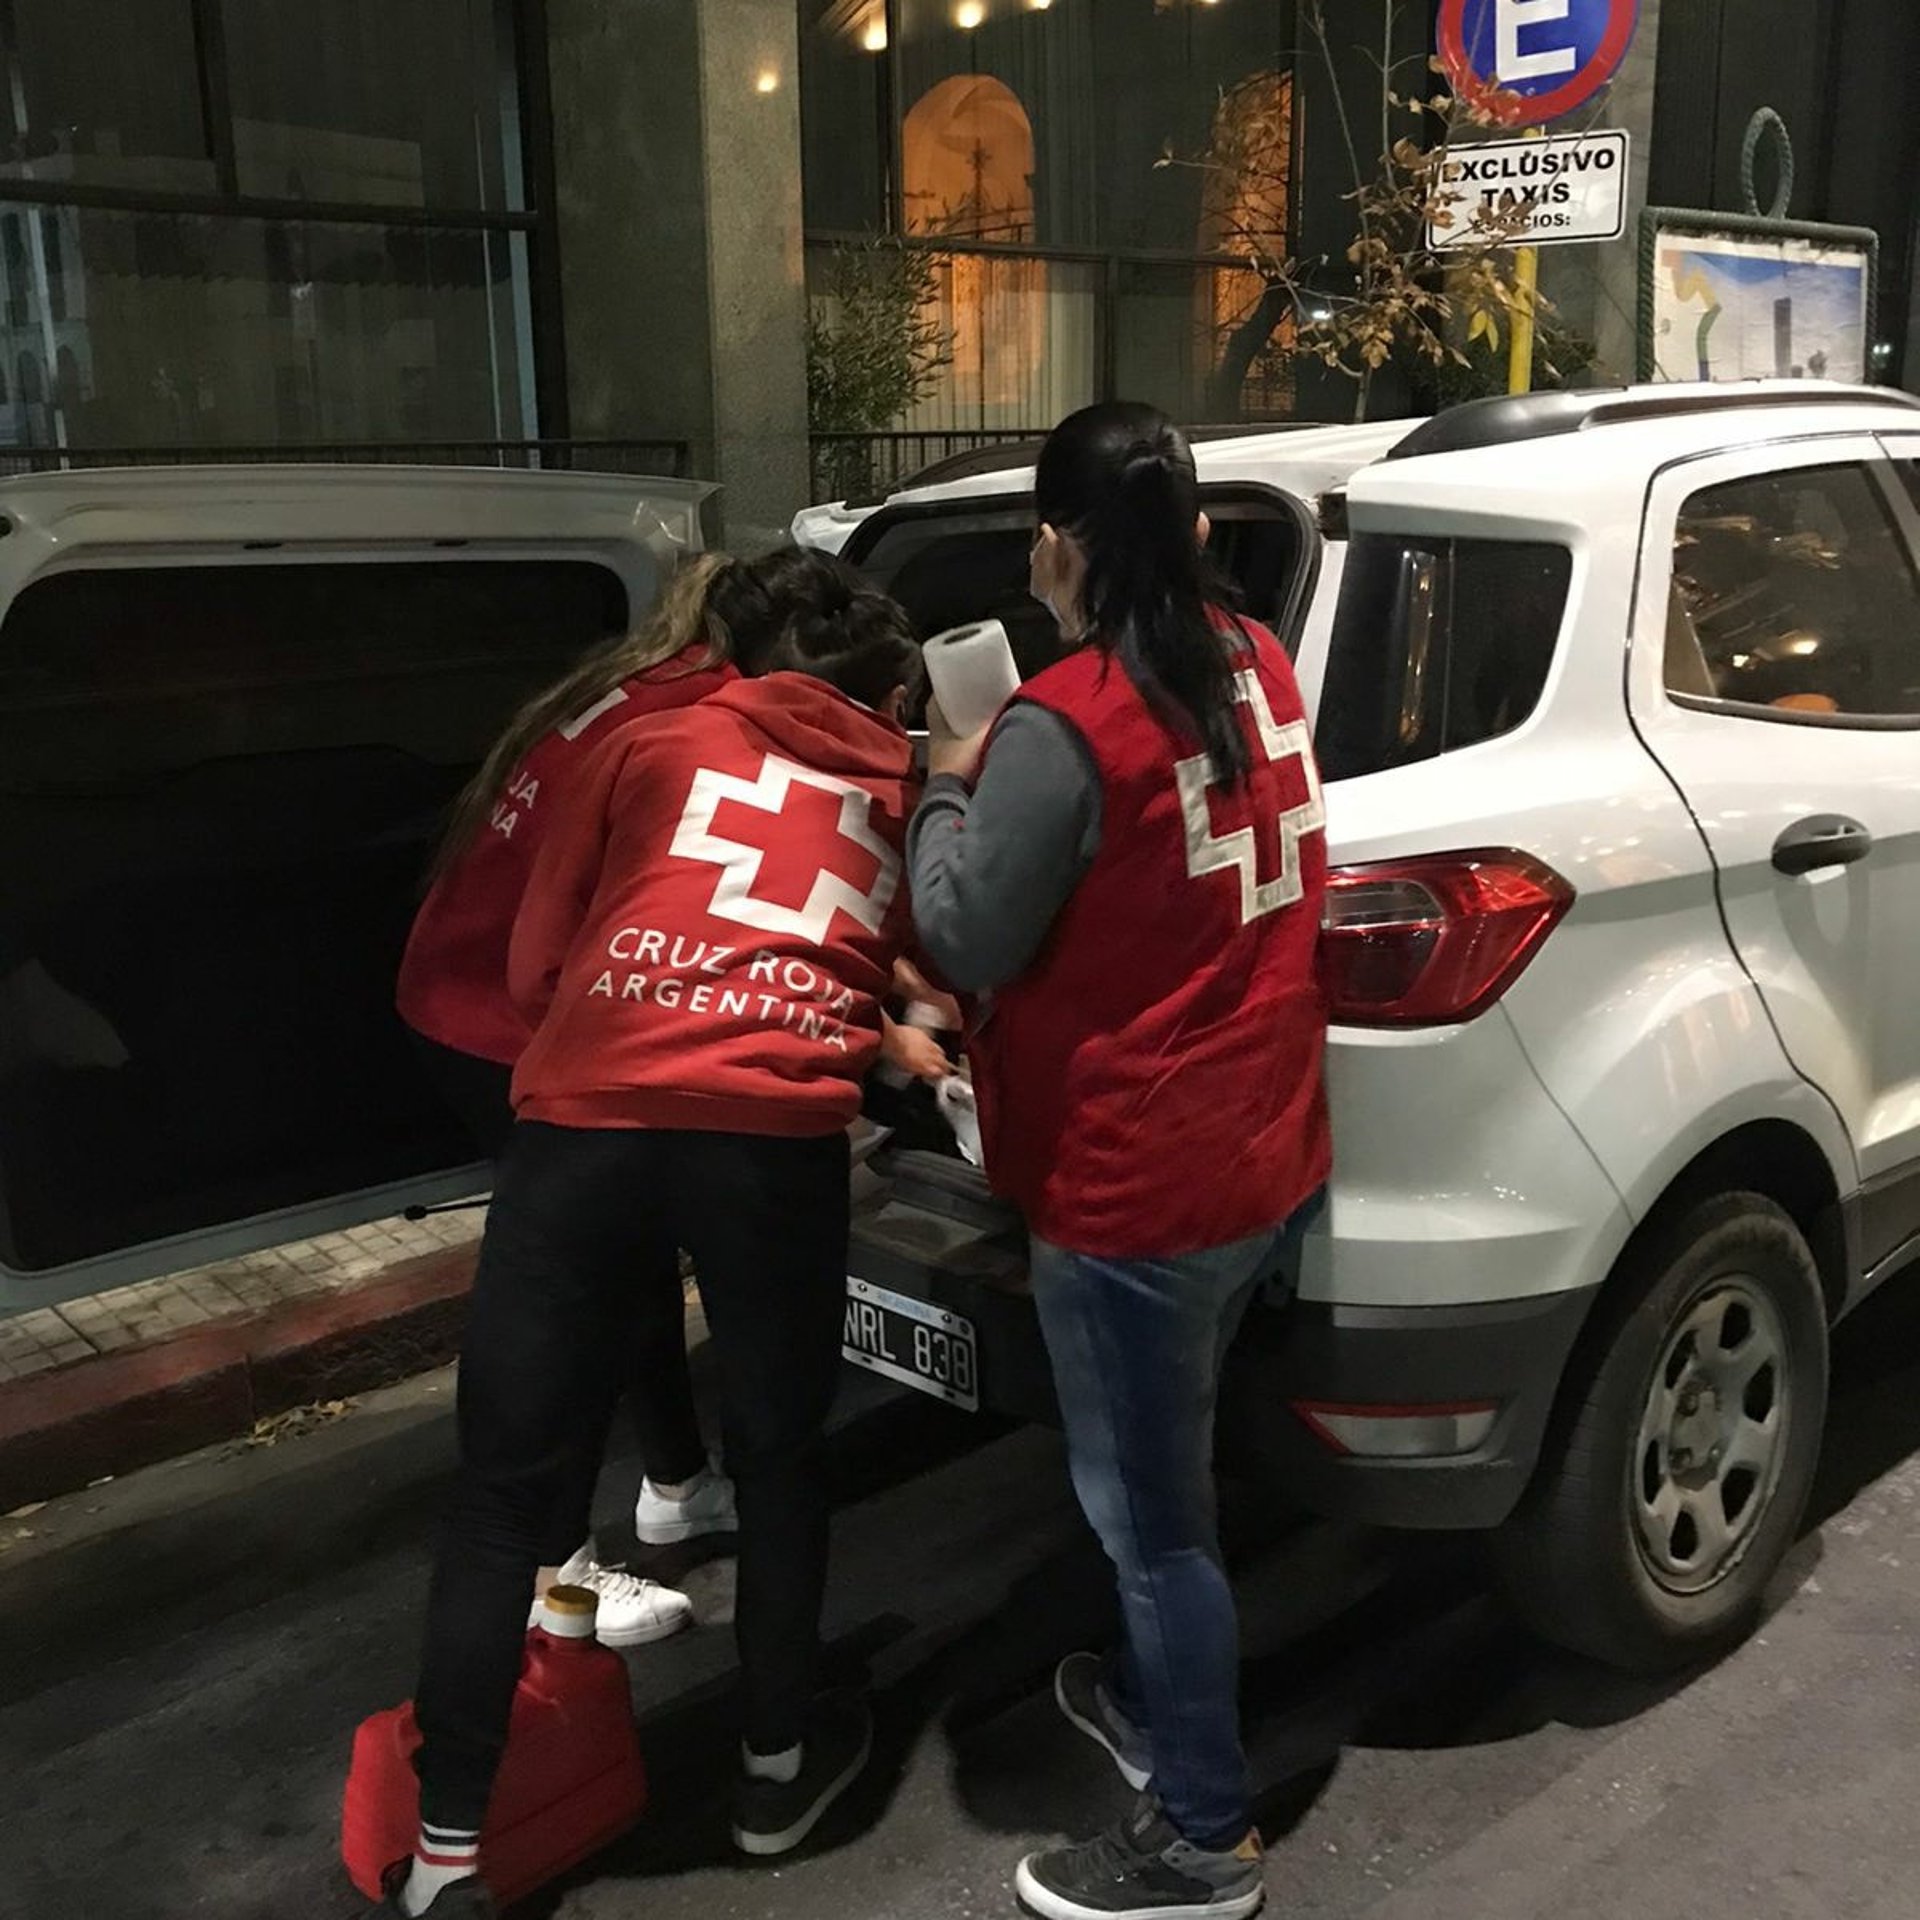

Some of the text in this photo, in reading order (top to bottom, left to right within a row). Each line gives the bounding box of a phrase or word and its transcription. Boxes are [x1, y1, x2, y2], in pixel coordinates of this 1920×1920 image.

[1496, 0, 1576, 82] E
[1481, 183, 1570, 209] TAXIS
[588, 970, 848, 1053] ARGENTINA
[608, 927, 855, 1018] CRUZ ROJA
[844, 1300, 897, 1362] NRL
[914, 1324, 970, 1390] 838
